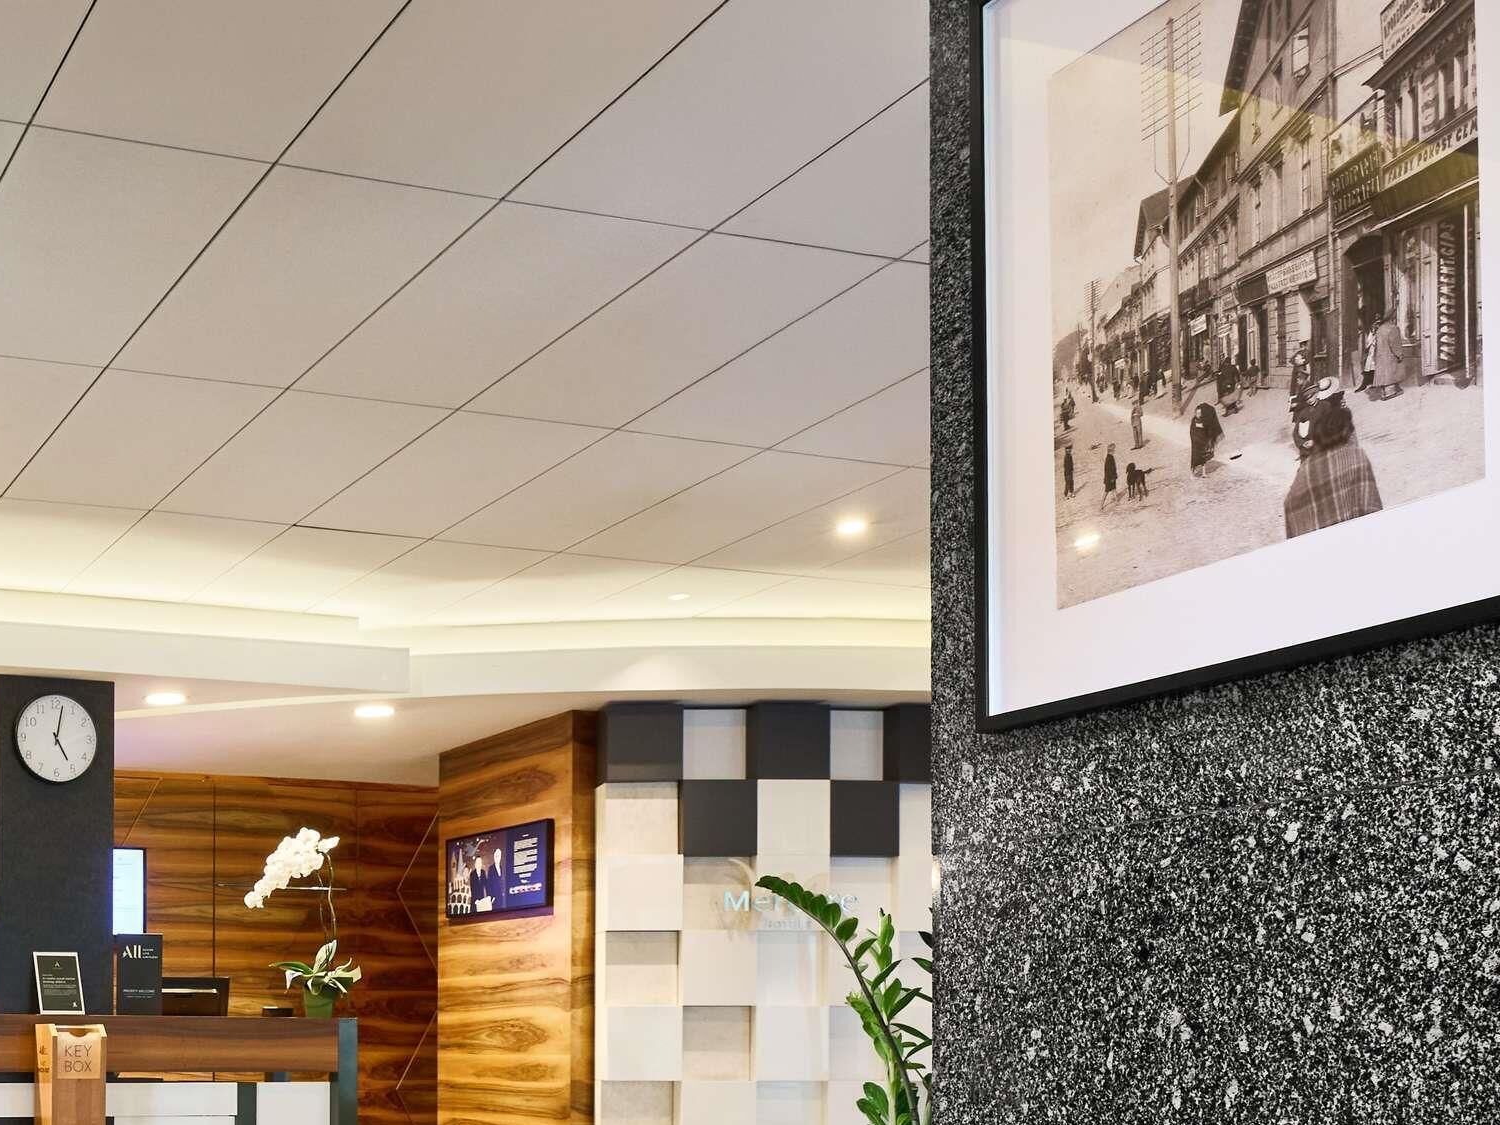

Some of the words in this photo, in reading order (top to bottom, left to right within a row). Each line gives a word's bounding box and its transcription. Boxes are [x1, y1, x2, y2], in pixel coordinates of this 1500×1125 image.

[1440, 315, 1456, 361] FARBY
[36, 704, 44, 714] 11
[51, 699, 61, 710] 12
[25, 717, 37, 728] 10
[80, 718, 87, 728] 2
[21, 731, 27, 742] 9
[85, 735, 93, 745] 3
[26, 750, 32, 760] 8
[81, 752, 87, 760] 4
[53, 767, 60, 777] 6
[64, 1044, 92, 1057] KEY
[64, 1060, 92, 1073] BOX
